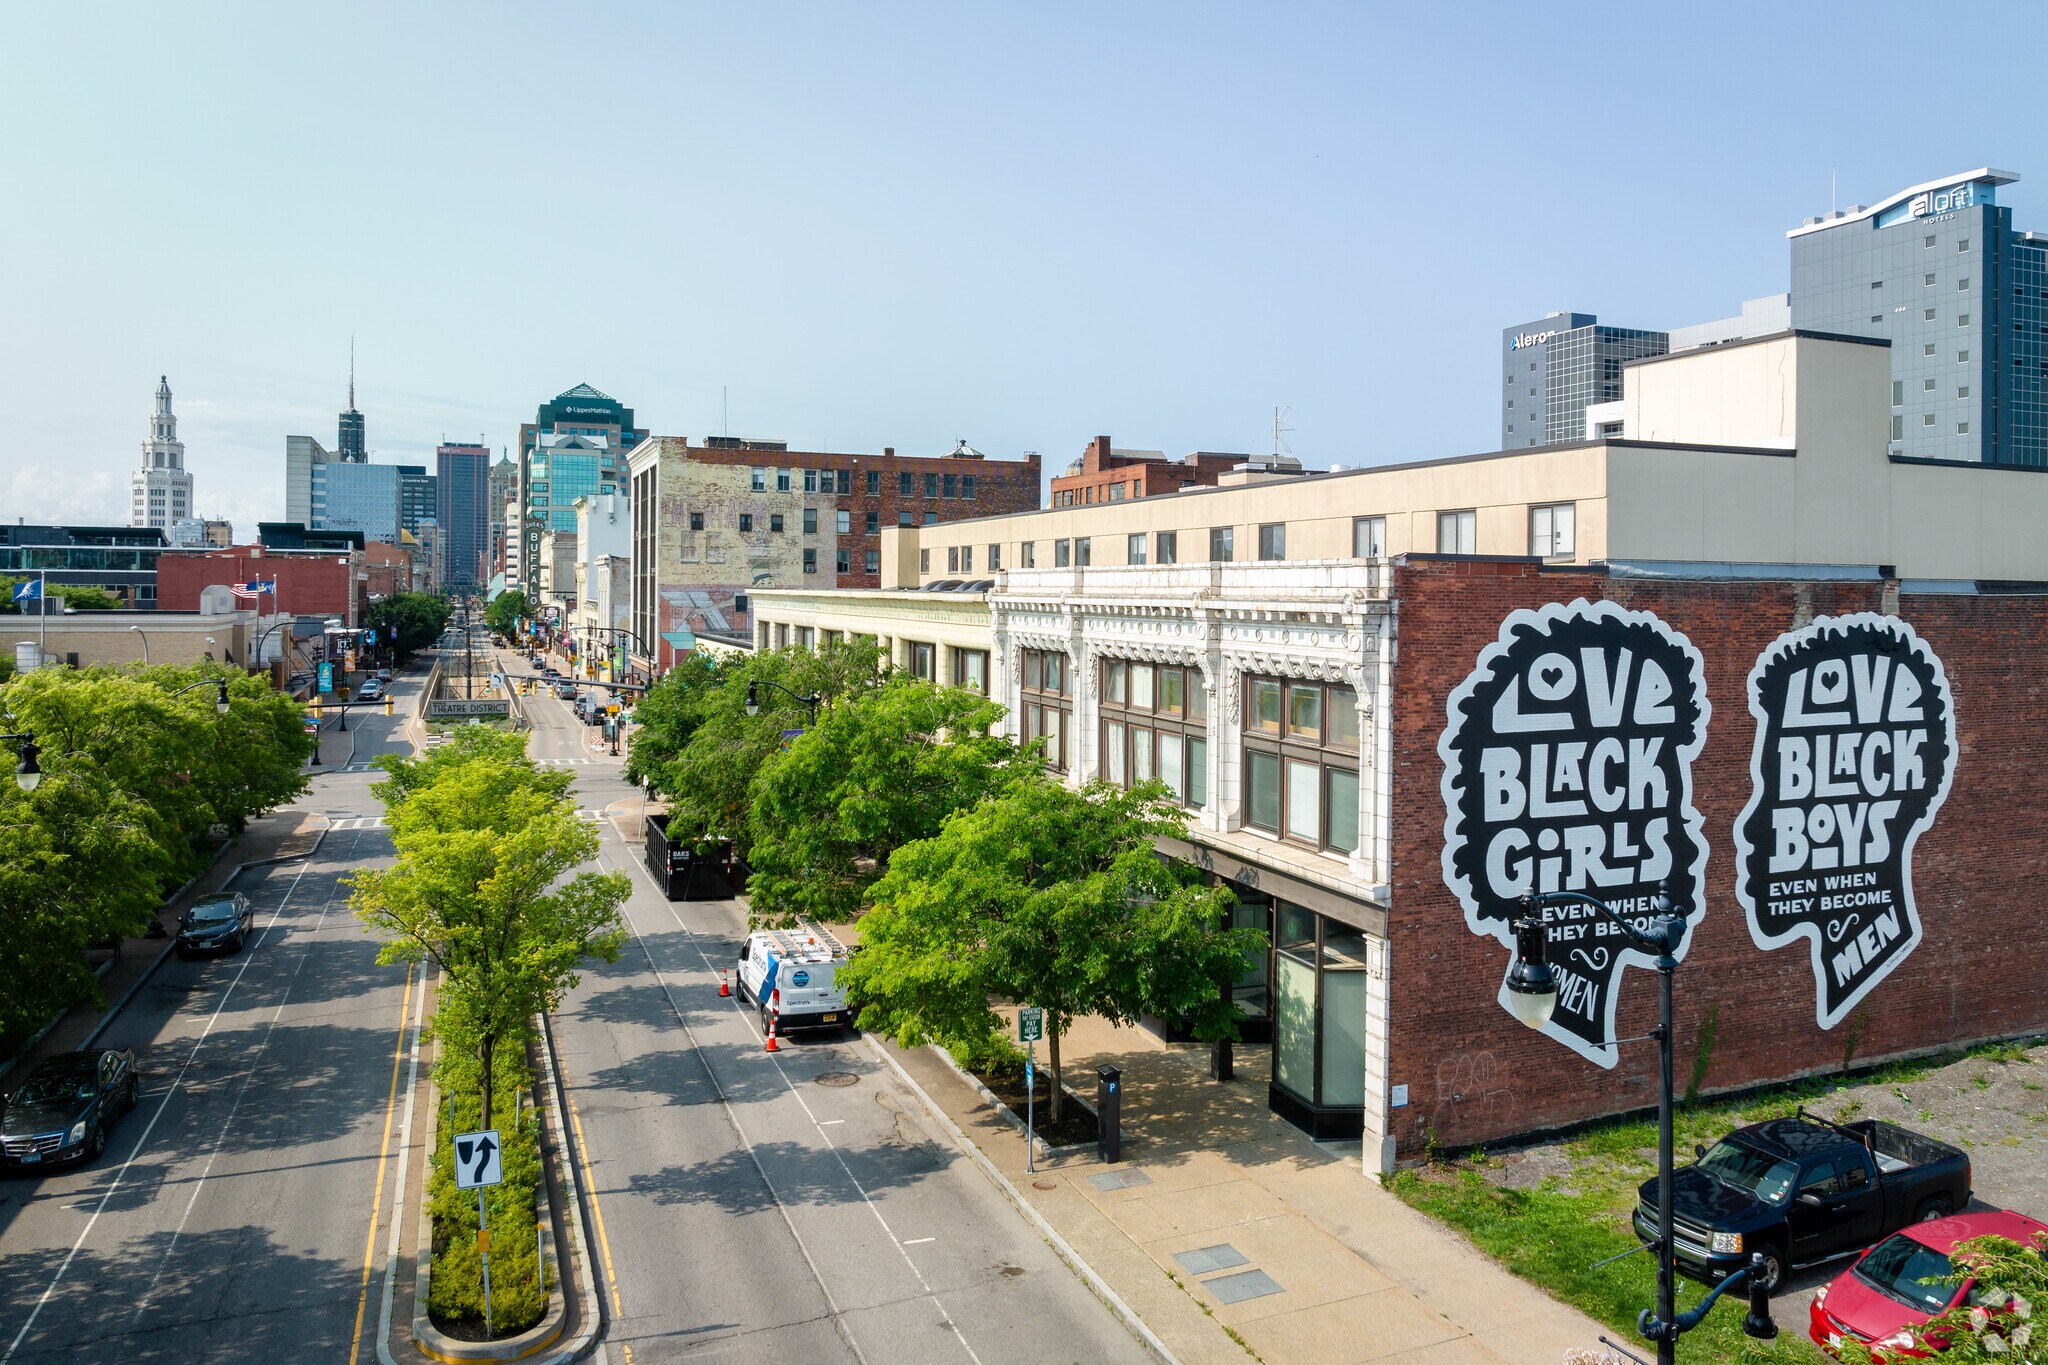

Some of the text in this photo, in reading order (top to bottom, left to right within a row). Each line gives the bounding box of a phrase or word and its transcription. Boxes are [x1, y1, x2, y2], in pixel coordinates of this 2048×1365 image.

[1913, 183, 1967, 216] aloft
[1923, 213, 1956, 226] HOTELS
[573, 406, 612, 414] LippesMathias
[525, 521, 544, 529] SHEA'S
[530, 532, 539, 605] BUFFALO
[433, 704, 508, 713] THEATRE DISTRICT
[1778, 729, 1928, 800] BLACK
[1480, 737, 1669, 822] BLACK
[1769, 800, 1901, 873] BOYS
[1769, 872, 1877, 897] EVEN WHEN
[1542, 895, 1662, 922] EVEN WHEN
[1768, 890, 1892, 916] THEY BECOME
[1548, 923, 1588, 942] HEY
[1832, 904, 1901, 988] MEN
[1549, 961, 1600, 1022] OMEN
[1110, 1083, 1115, 1092] P
